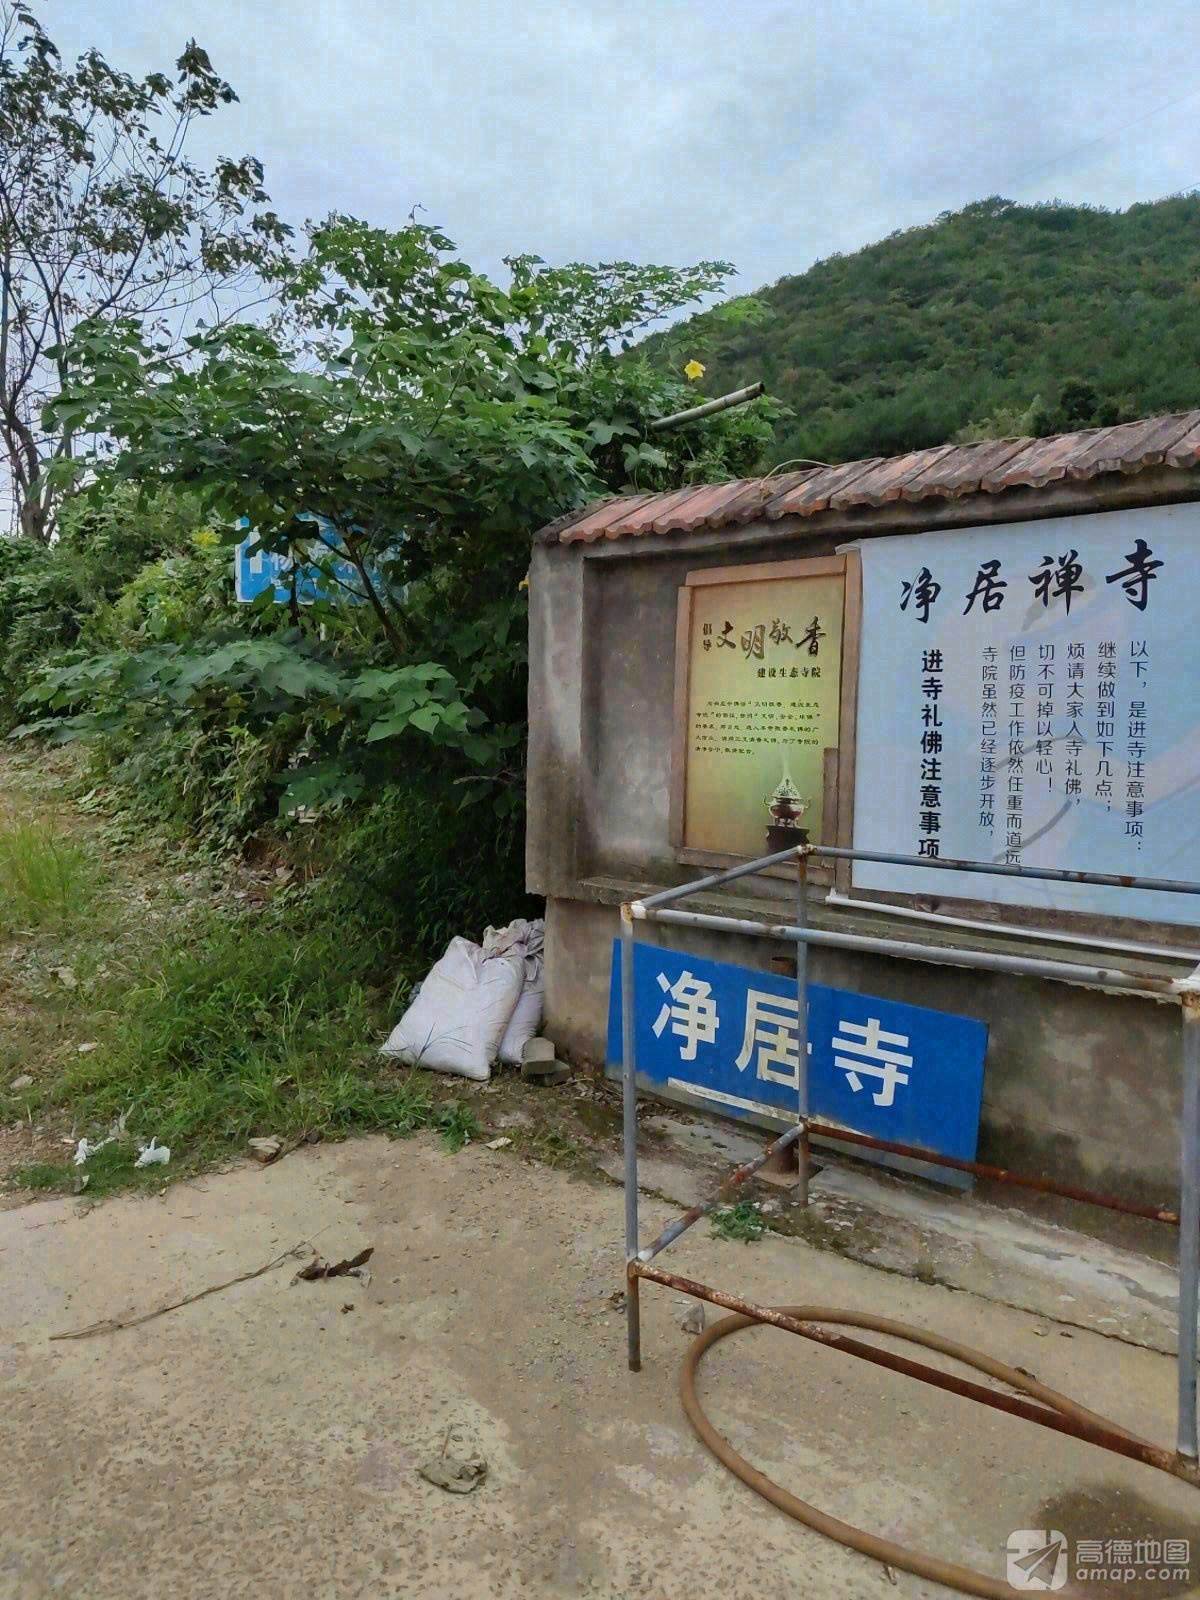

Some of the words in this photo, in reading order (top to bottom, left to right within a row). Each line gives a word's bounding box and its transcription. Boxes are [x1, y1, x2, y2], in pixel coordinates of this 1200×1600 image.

[900, 539, 1165, 624] 净居禅寺
[716, 616, 827, 660] 文明敬香
[757, 666, 821, 678] 建设生态寺院
[918, 649, 944, 859] 进寺礼佛注意事项
[651, 970, 914, 1106] 净居寺
